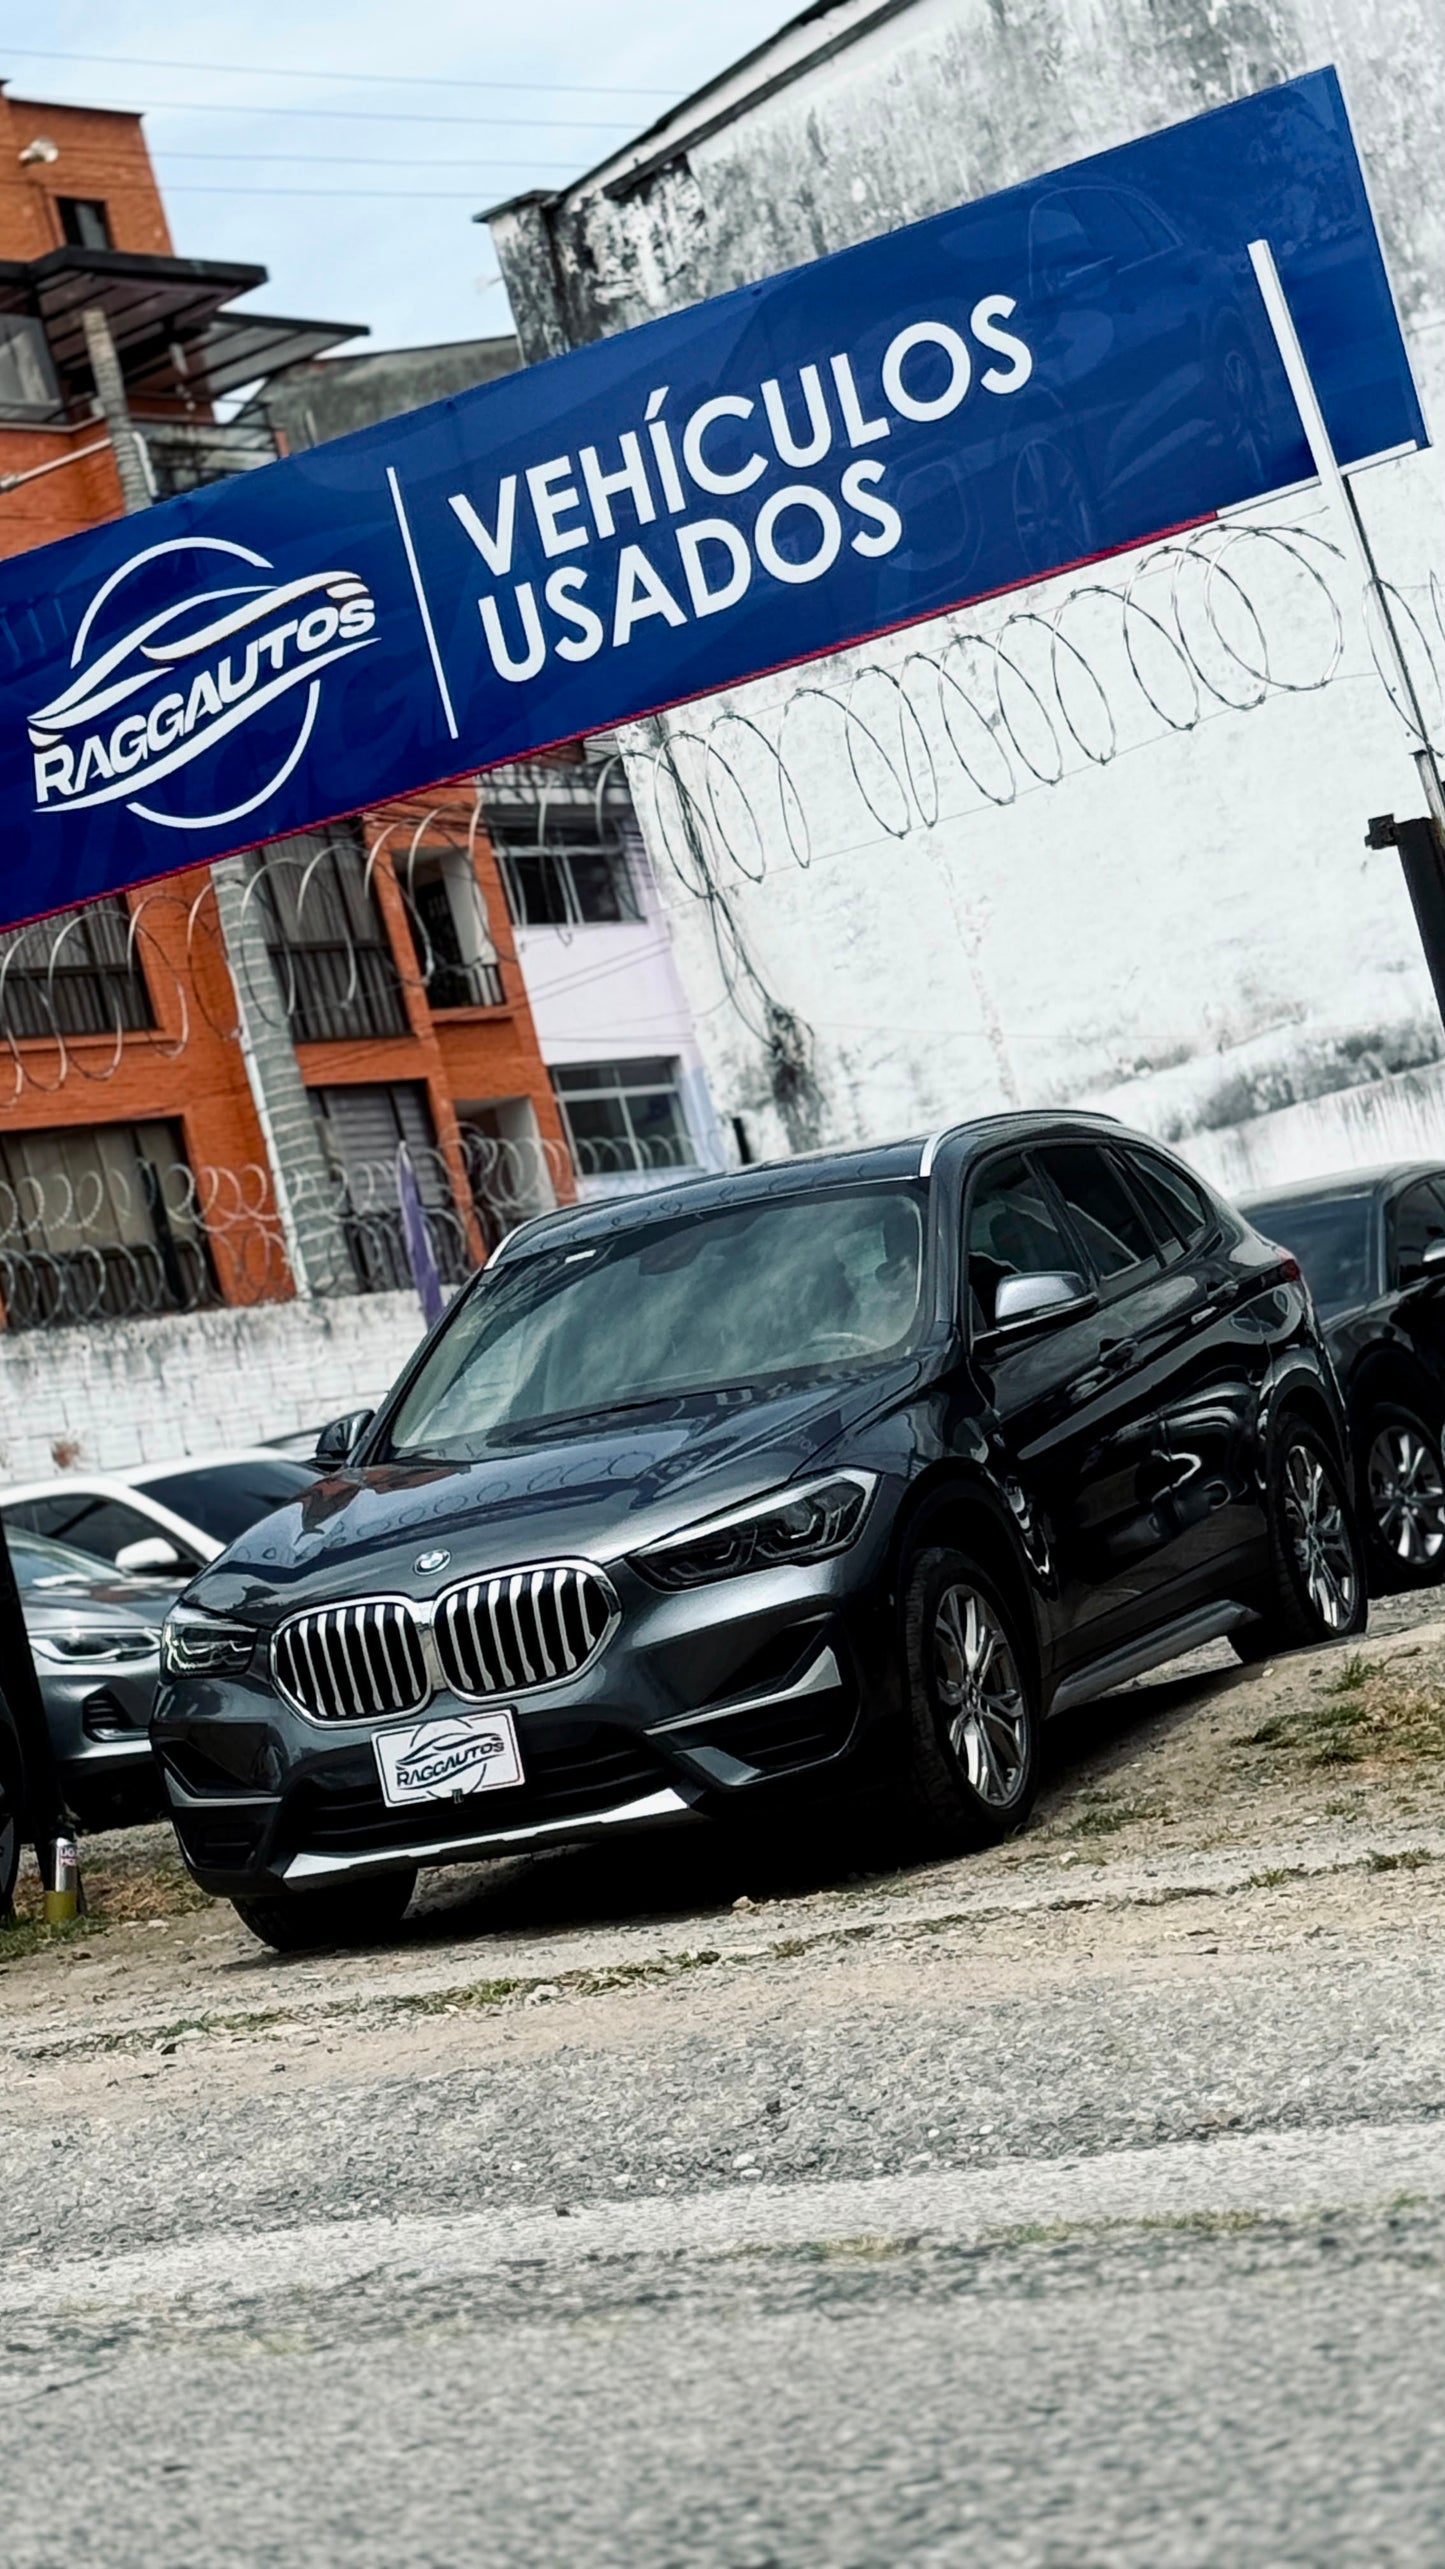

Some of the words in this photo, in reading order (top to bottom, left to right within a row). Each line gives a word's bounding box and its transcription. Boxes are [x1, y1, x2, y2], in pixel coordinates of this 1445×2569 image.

[448, 294, 1033, 577] VEHÍCULOS
[478, 460, 902, 682] USADOS
[33, 598, 376, 803] RAGGAUTOS
[397, 1741, 505, 1787] RAGGAUTOS
